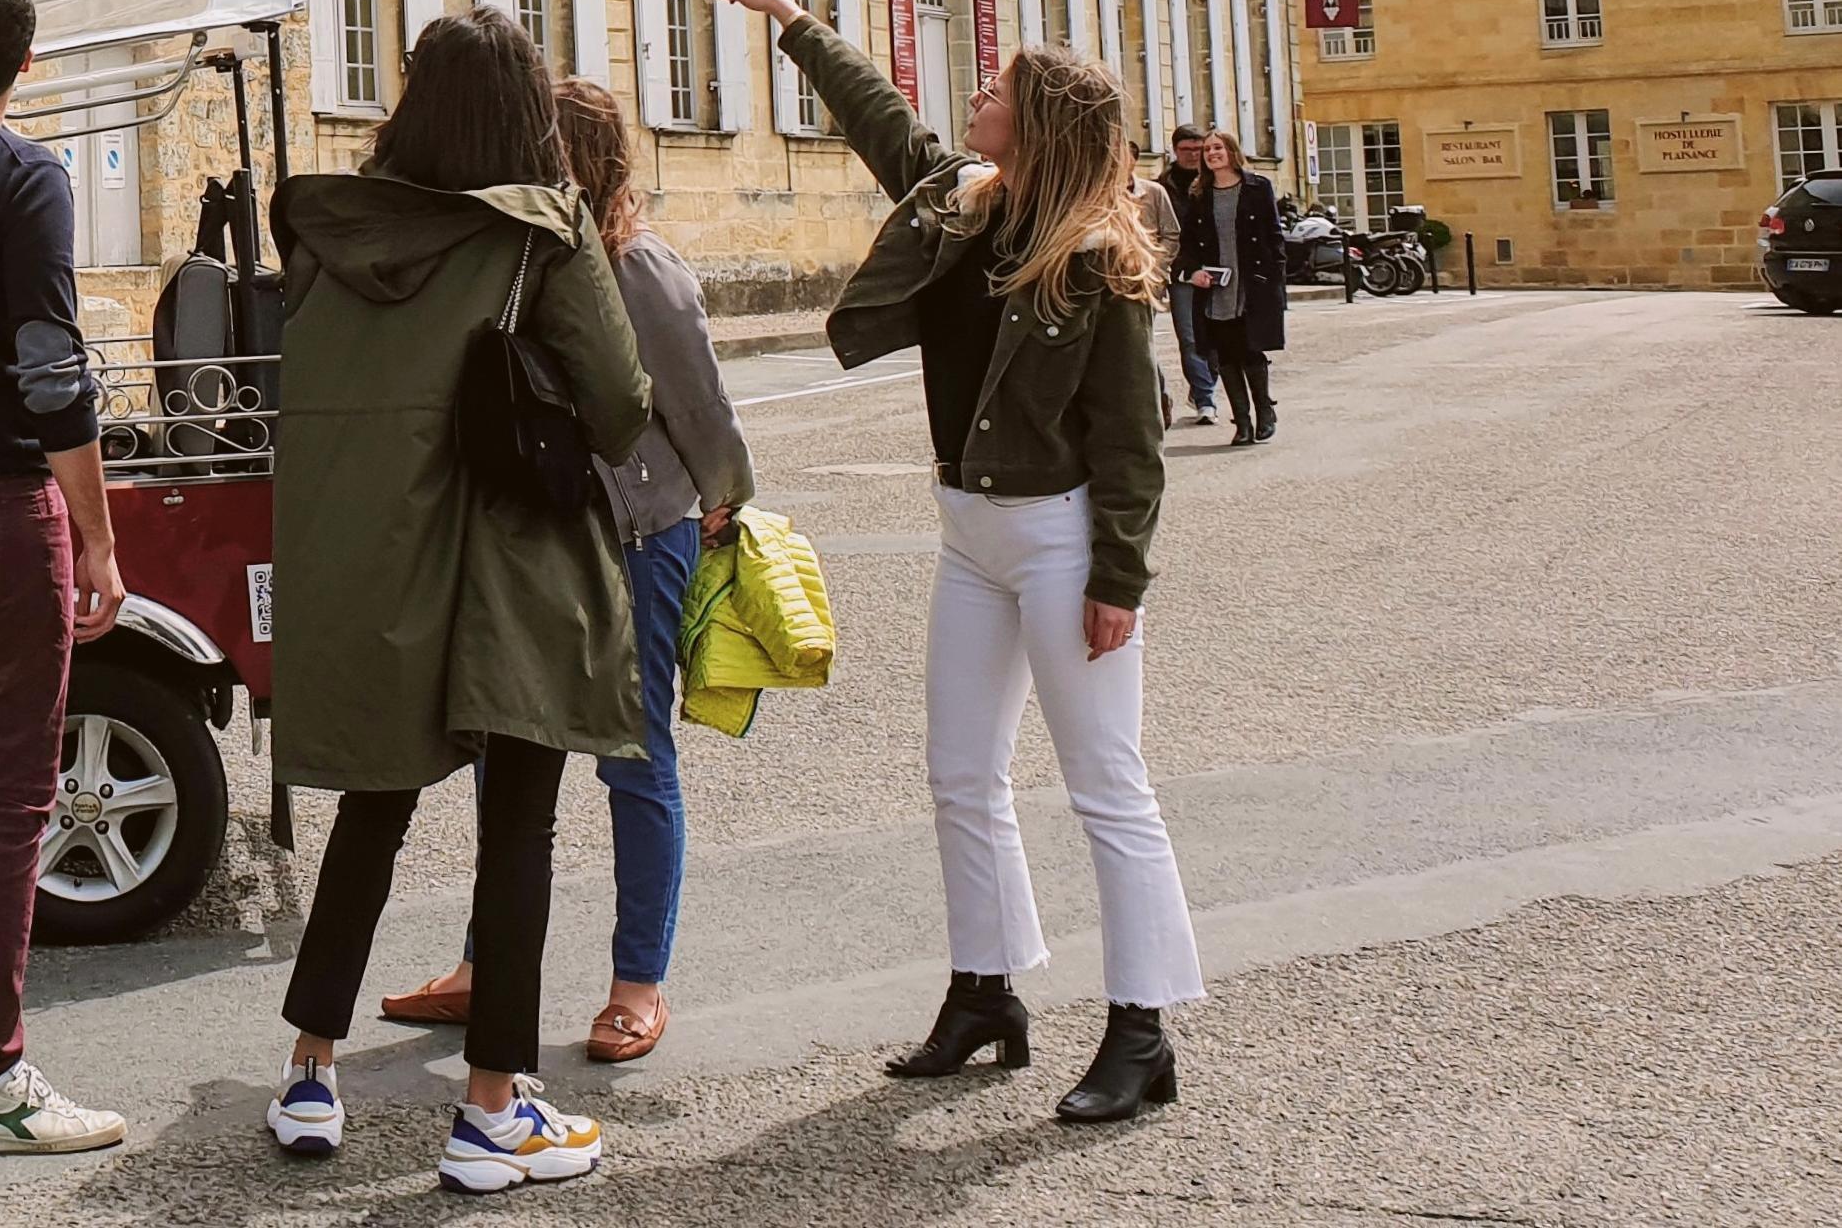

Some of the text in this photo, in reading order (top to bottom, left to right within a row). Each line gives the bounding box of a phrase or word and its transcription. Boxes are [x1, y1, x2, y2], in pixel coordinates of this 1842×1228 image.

[1654, 128, 1724, 140] HOSTELLERIE
[1441, 140, 1502, 151] RESTAURANT
[1683, 140, 1694, 149] DE
[1443, 155, 1503, 166] SALON BAR
[1662, 149, 1718, 161] PLAISANCE
